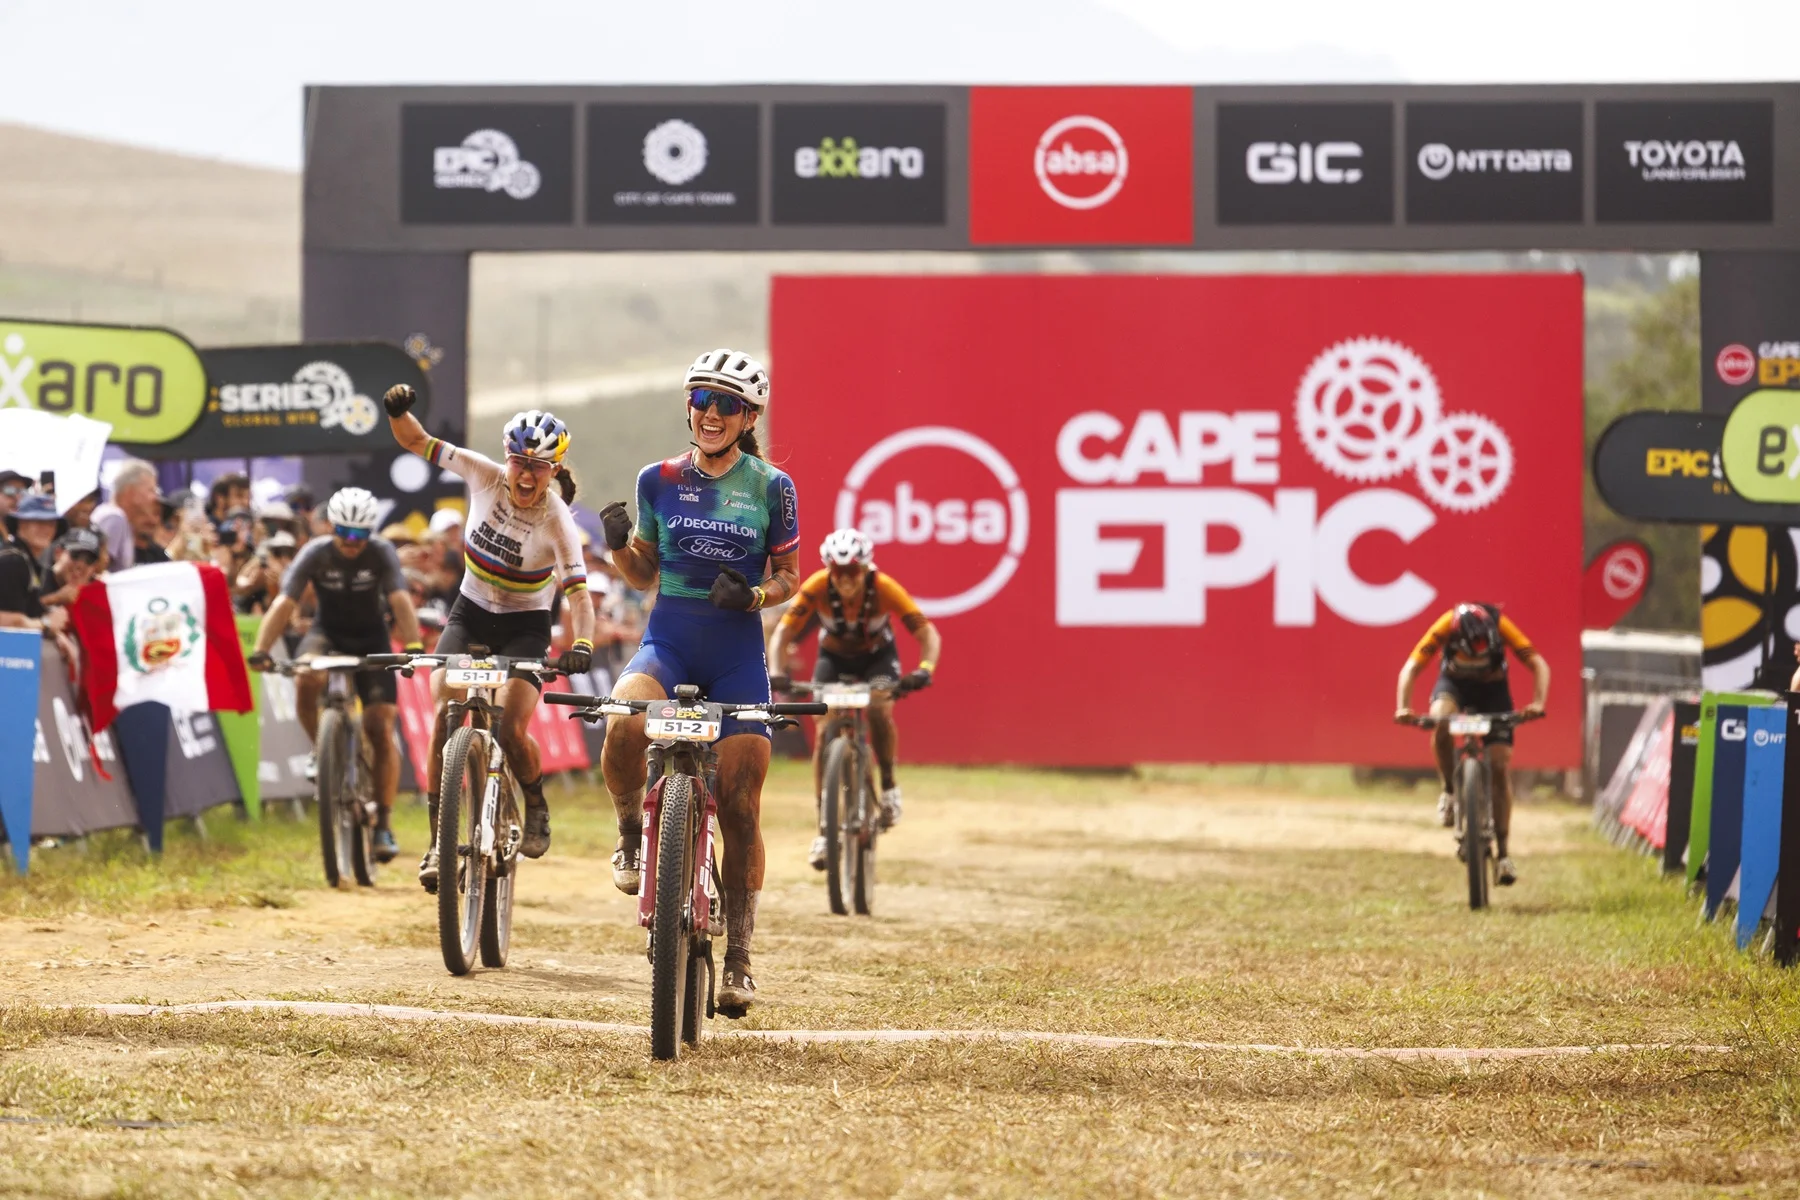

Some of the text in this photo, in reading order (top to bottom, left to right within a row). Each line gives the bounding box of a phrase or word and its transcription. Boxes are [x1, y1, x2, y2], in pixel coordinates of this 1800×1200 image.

[794, 136, 923, 178] exxaro
[1046, 142, 1116, 175] absa
[1247, 141, 1363, 184] GIC
[1624, 140, 1745, 167] TOYOTA
[219, 383, 331, 412] SERIES
[1055, 411, 1280, 484] CAPE
[1646, 448, 1709, 477] EPIC
[858, 481, 1006, 545] absa
[478, 521, 497, 541] SHE
[494, 533, 522, 554] SENDS
[683, 517, 757, 539] DECATHLON
[690, 538, 736, 558] Ford
[1055, 487, 1438, 627] EPIC
[462, 672, 491, 681] 51-1
[664, 721, 702, 733] 51-2
[676, 711, 702, 719] EPIC
